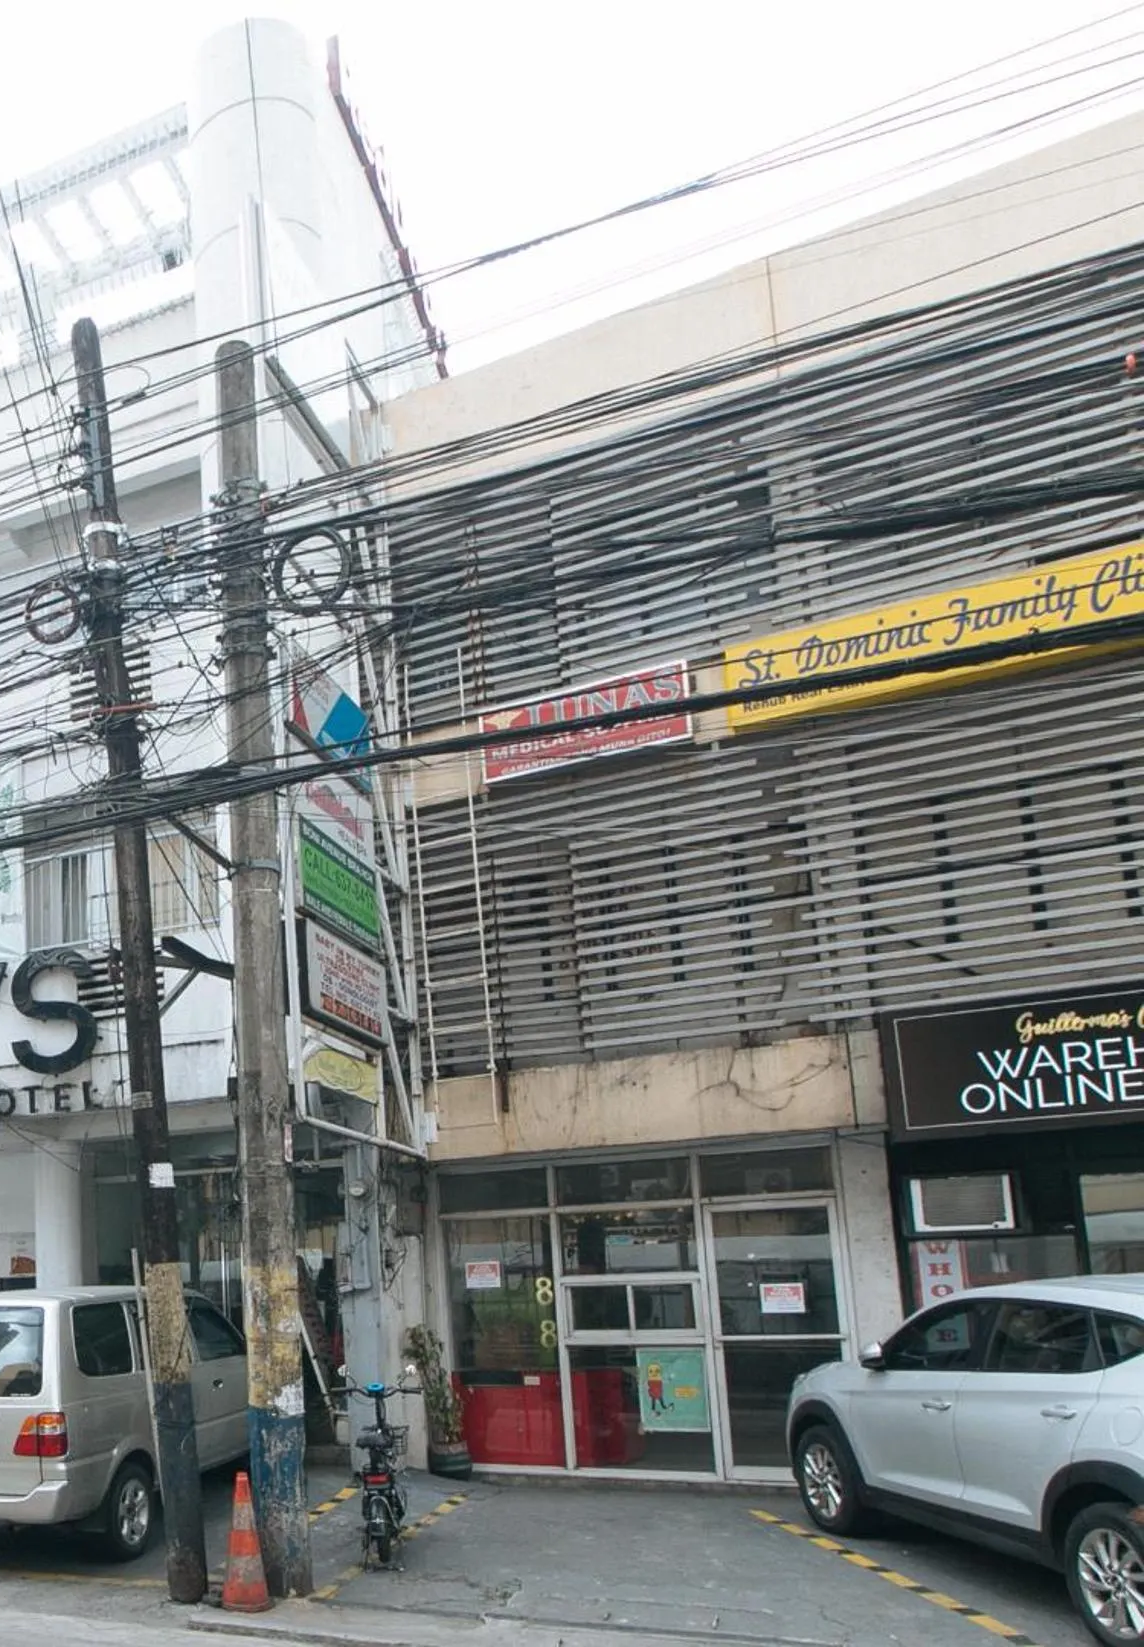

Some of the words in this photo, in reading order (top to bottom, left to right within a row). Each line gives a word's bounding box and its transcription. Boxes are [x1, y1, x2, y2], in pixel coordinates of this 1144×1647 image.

[739, 649, 781, 688] St.
[796, 610, 933, 673] Dominic
[943, 575, 1077, 645] Family
[961, 1069, 1144, 1114] ONLINE
